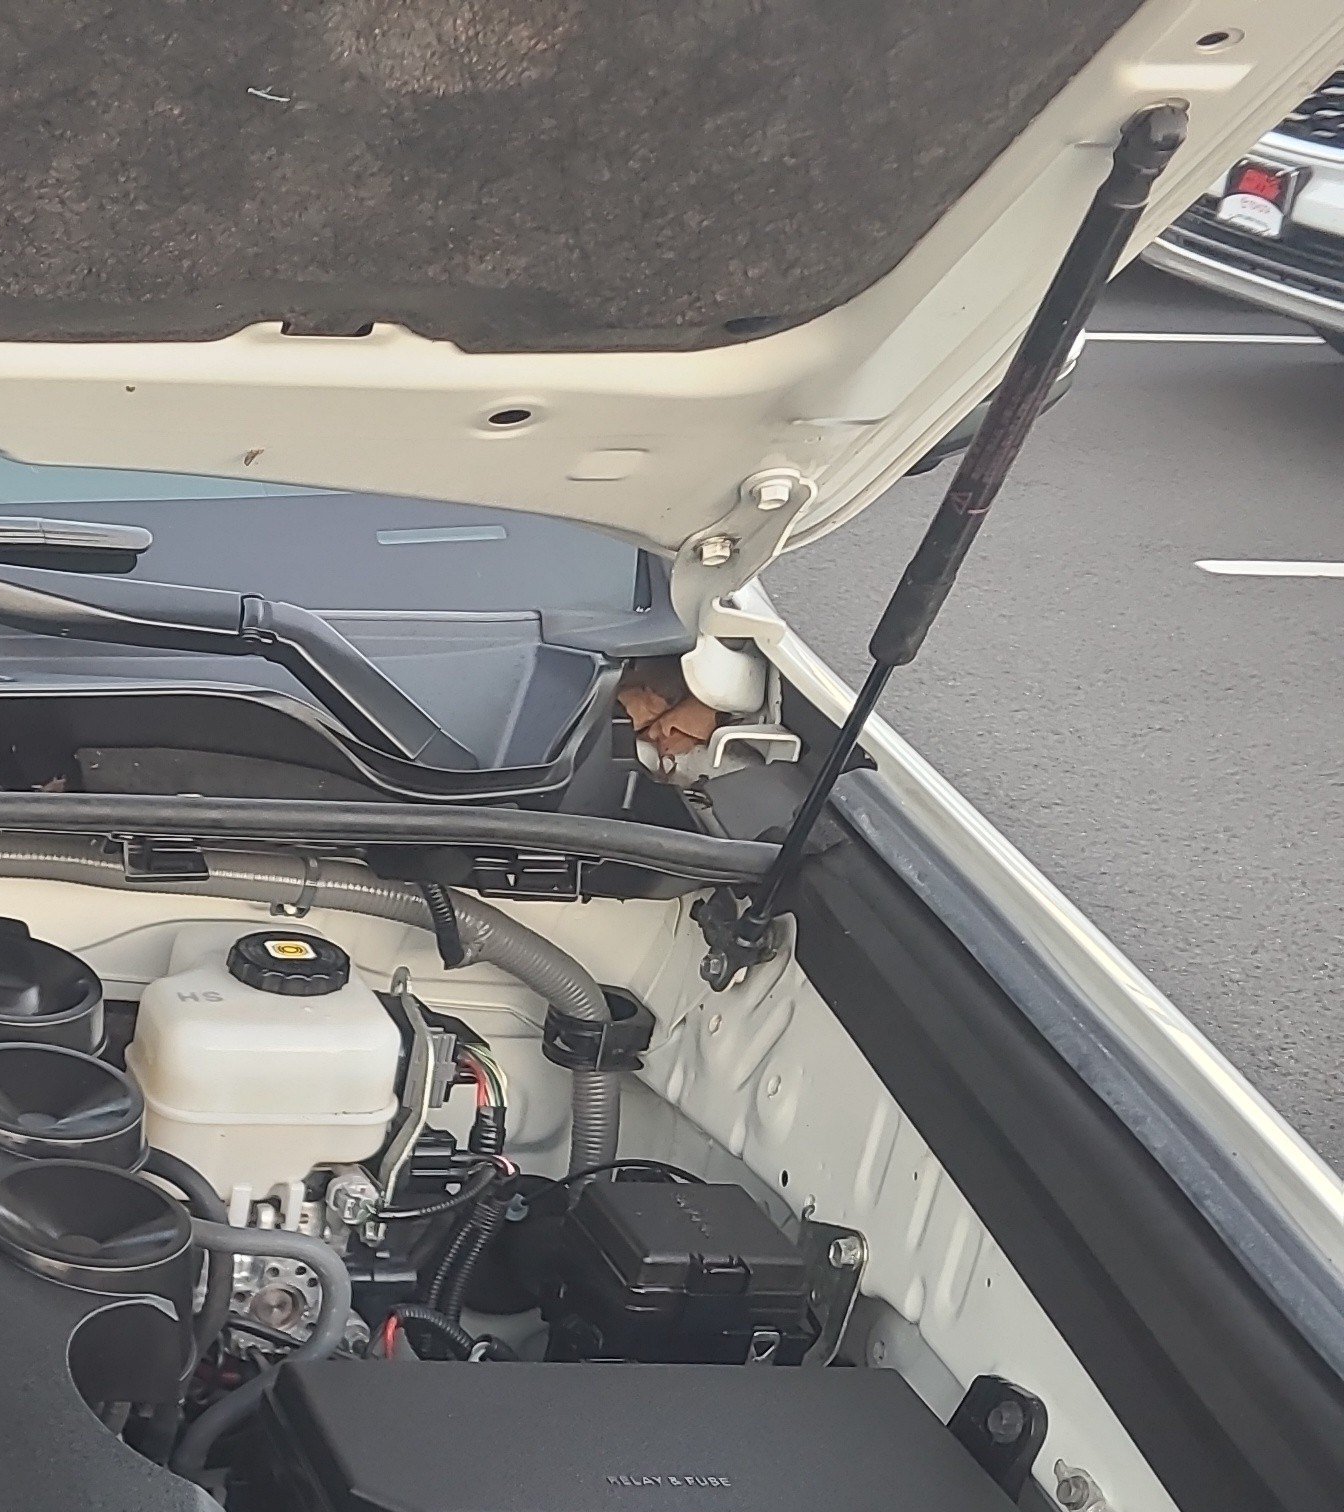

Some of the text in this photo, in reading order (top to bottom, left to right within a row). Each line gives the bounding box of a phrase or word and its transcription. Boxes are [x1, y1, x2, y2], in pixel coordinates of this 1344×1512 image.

[176, 991, 223, 1002] HS
[606, 1475, 662, 1486] RELAY
[667, 1476, 682, 1486] &
